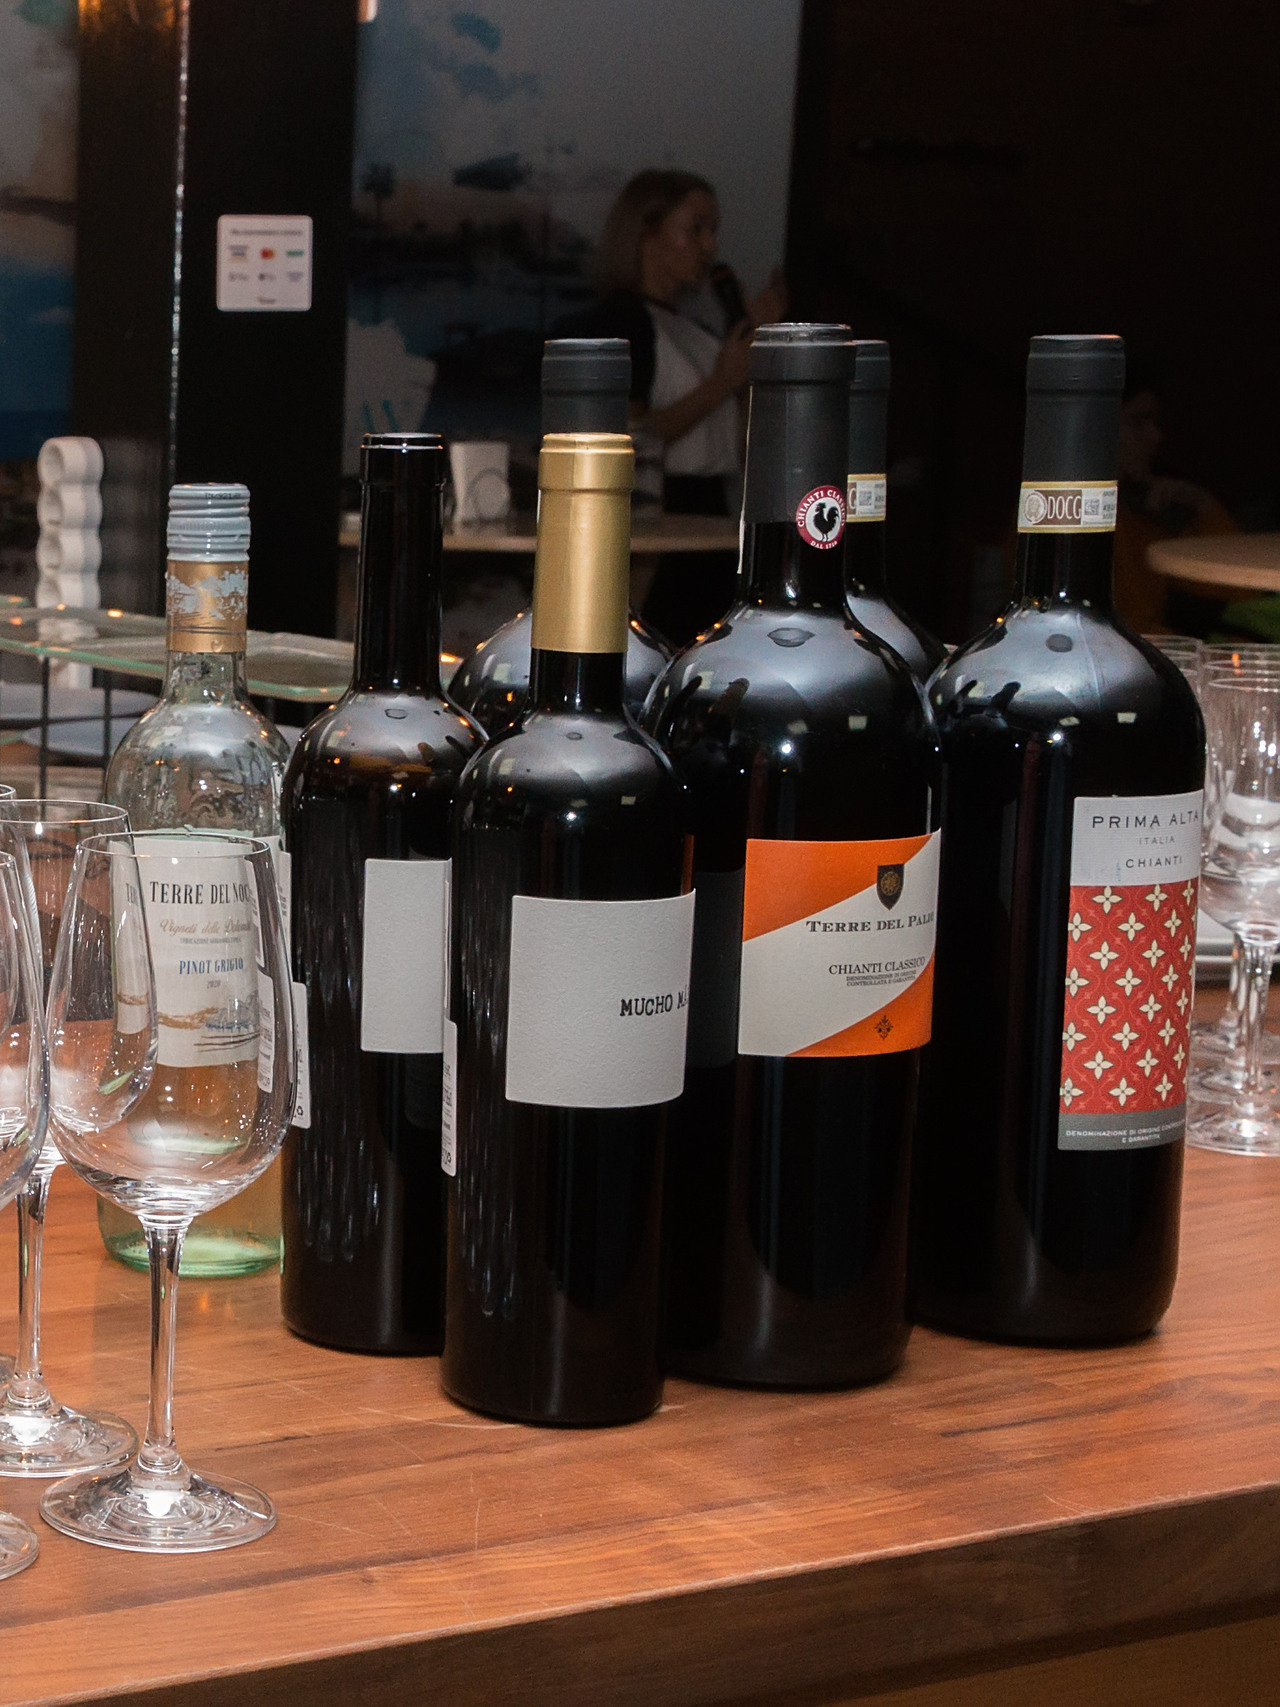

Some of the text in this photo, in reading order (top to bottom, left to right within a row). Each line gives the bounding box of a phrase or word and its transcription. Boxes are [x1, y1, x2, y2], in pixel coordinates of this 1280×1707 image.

[798, 490, 824, 527] CHIANTI
[1047, 496, 1081, 519] DOCG
[810, 540, 824, 549] DAL
[1092, 810, 1199, 828] PRIMA ALTA
[1139, 836, 1176, 845] ITALIA
[1125, 856, 1182, 869] CHIANTI
[149, 881, 204, 905] TERRE
[210, 884, 230, 905] DEL
[232, 882, 250, 903] NOC
[179, 957, 244, 975] PINOT GRIGIO
[828, 956, 926, 975] CHIANTI CLASSICO
[619, 994, 674, 1016] MUCHO
